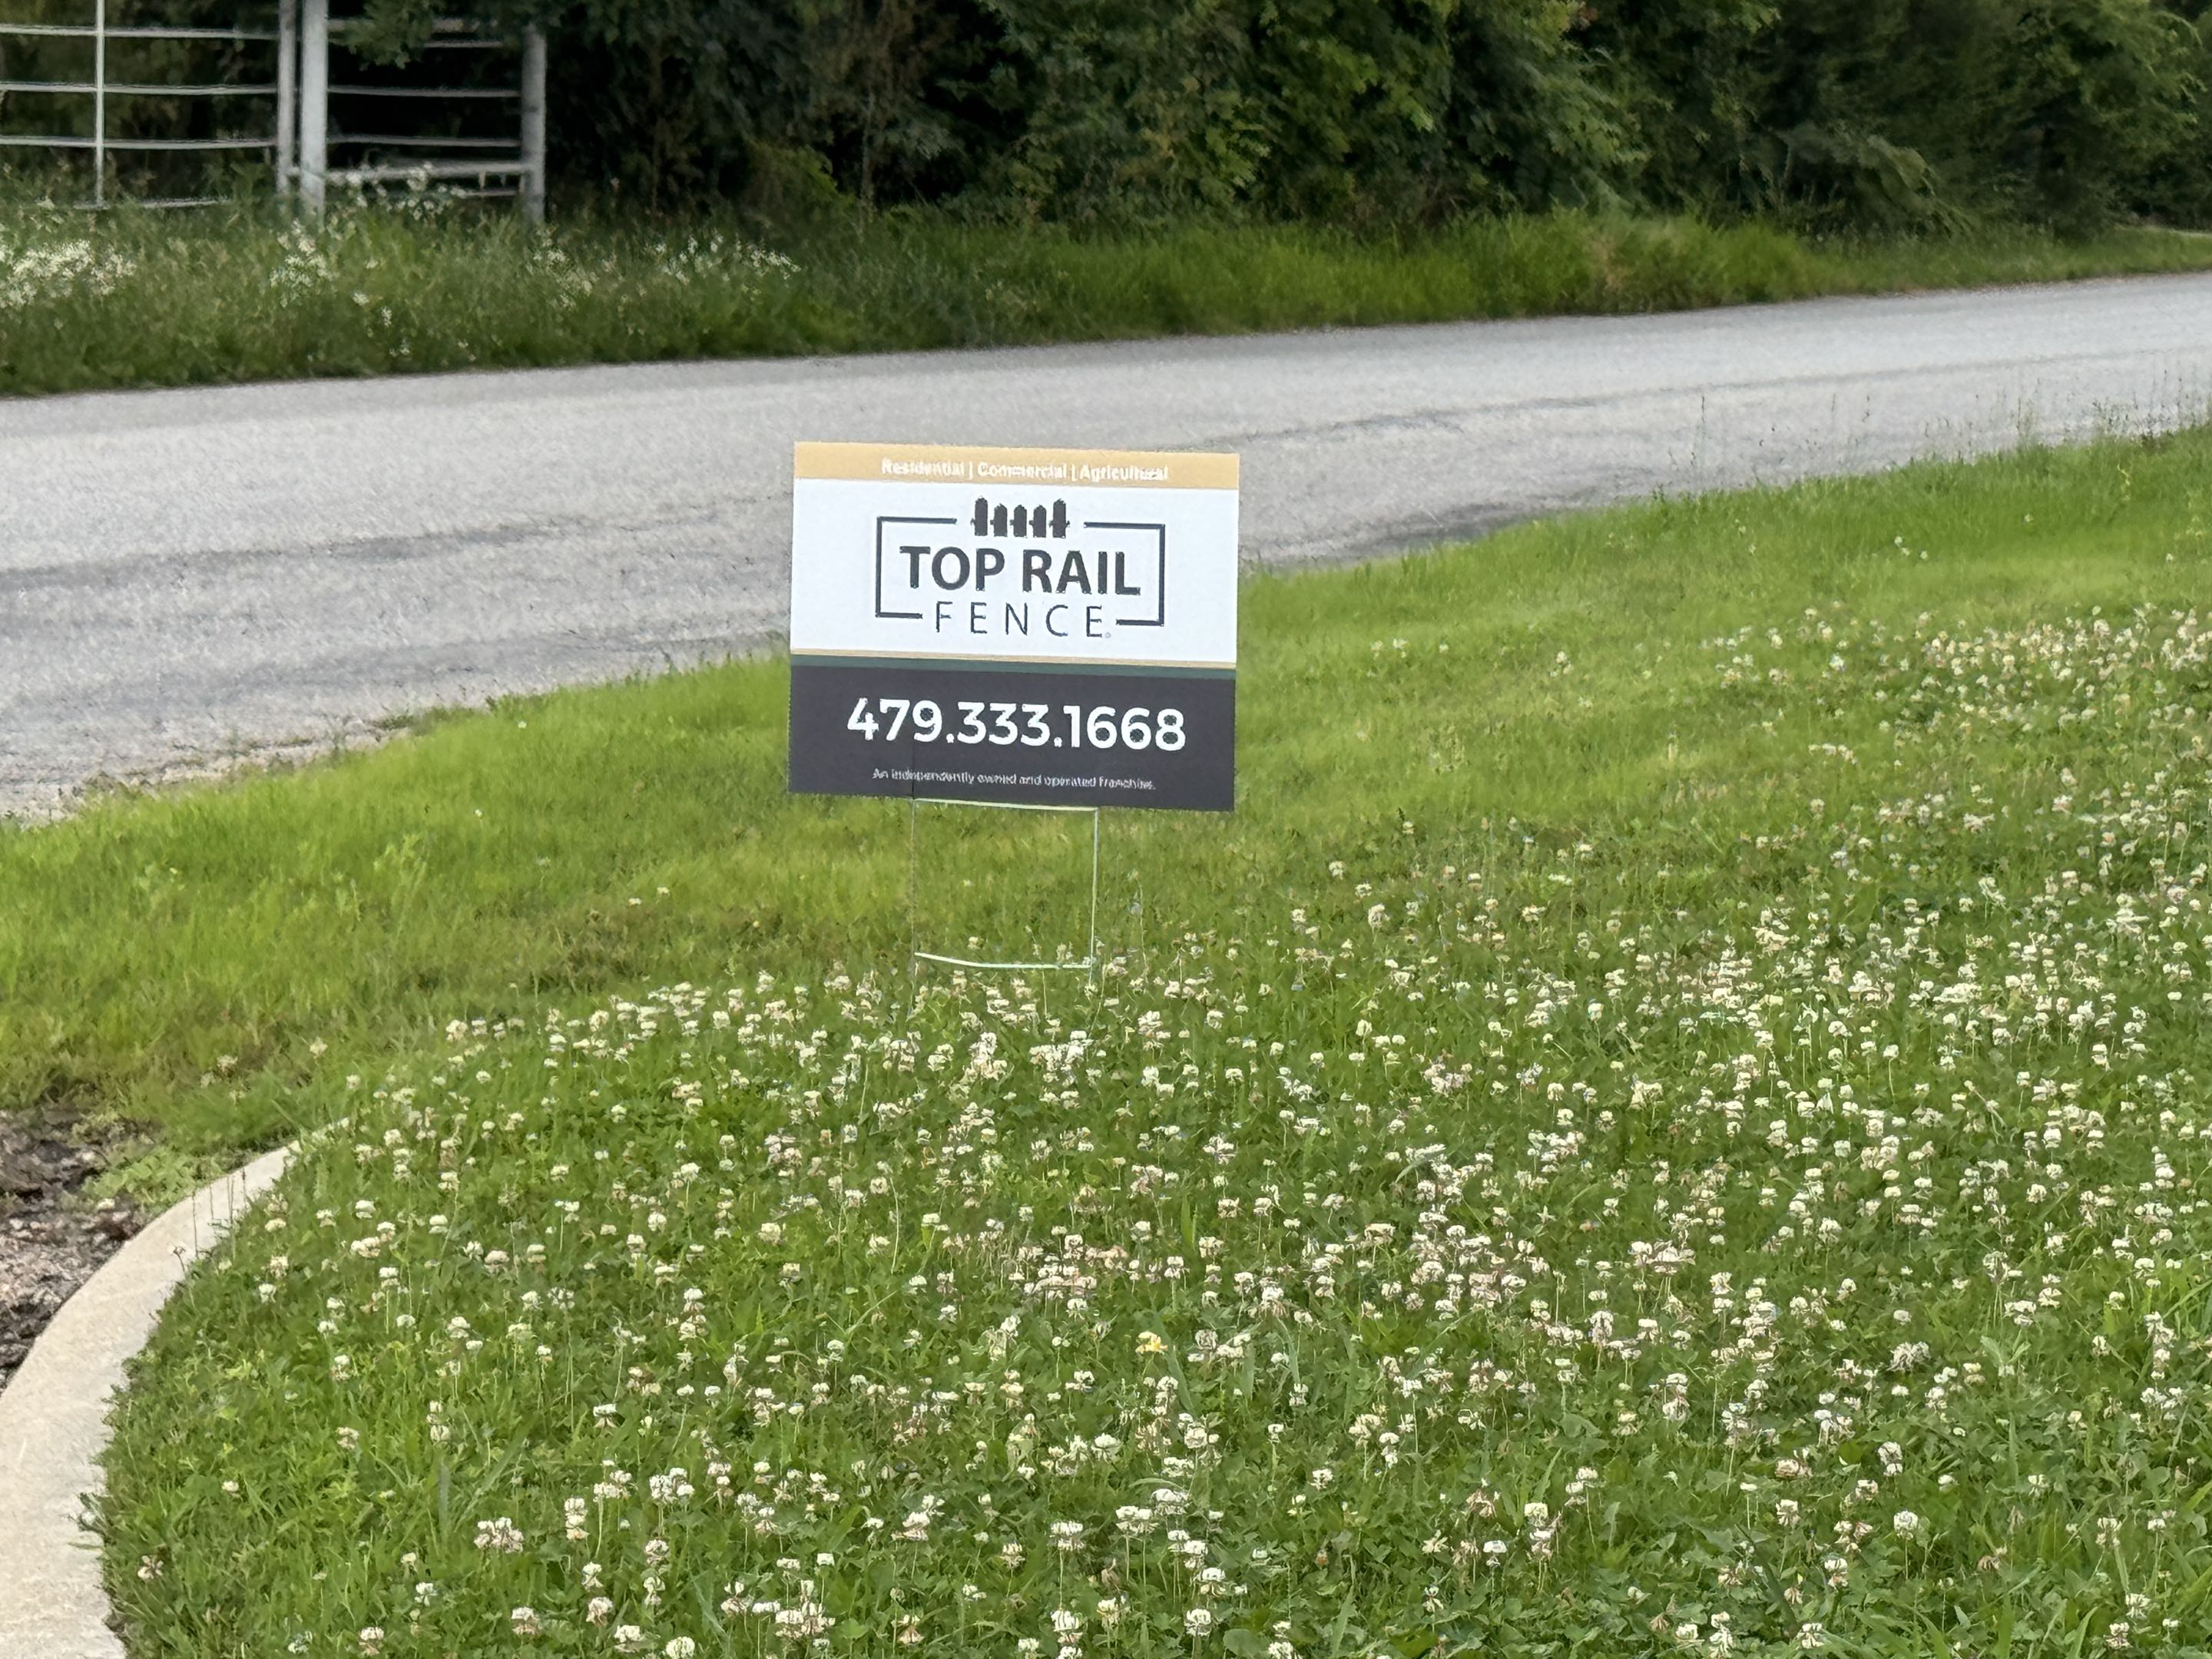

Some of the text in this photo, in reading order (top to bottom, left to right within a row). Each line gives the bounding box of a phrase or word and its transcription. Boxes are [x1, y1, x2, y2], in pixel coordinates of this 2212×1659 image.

[899, 546, 1141, 594] TOP RAIL
[935, 601, 1103, 637] FENCE
[847, 697, 1186, 751] 479.333.1668
